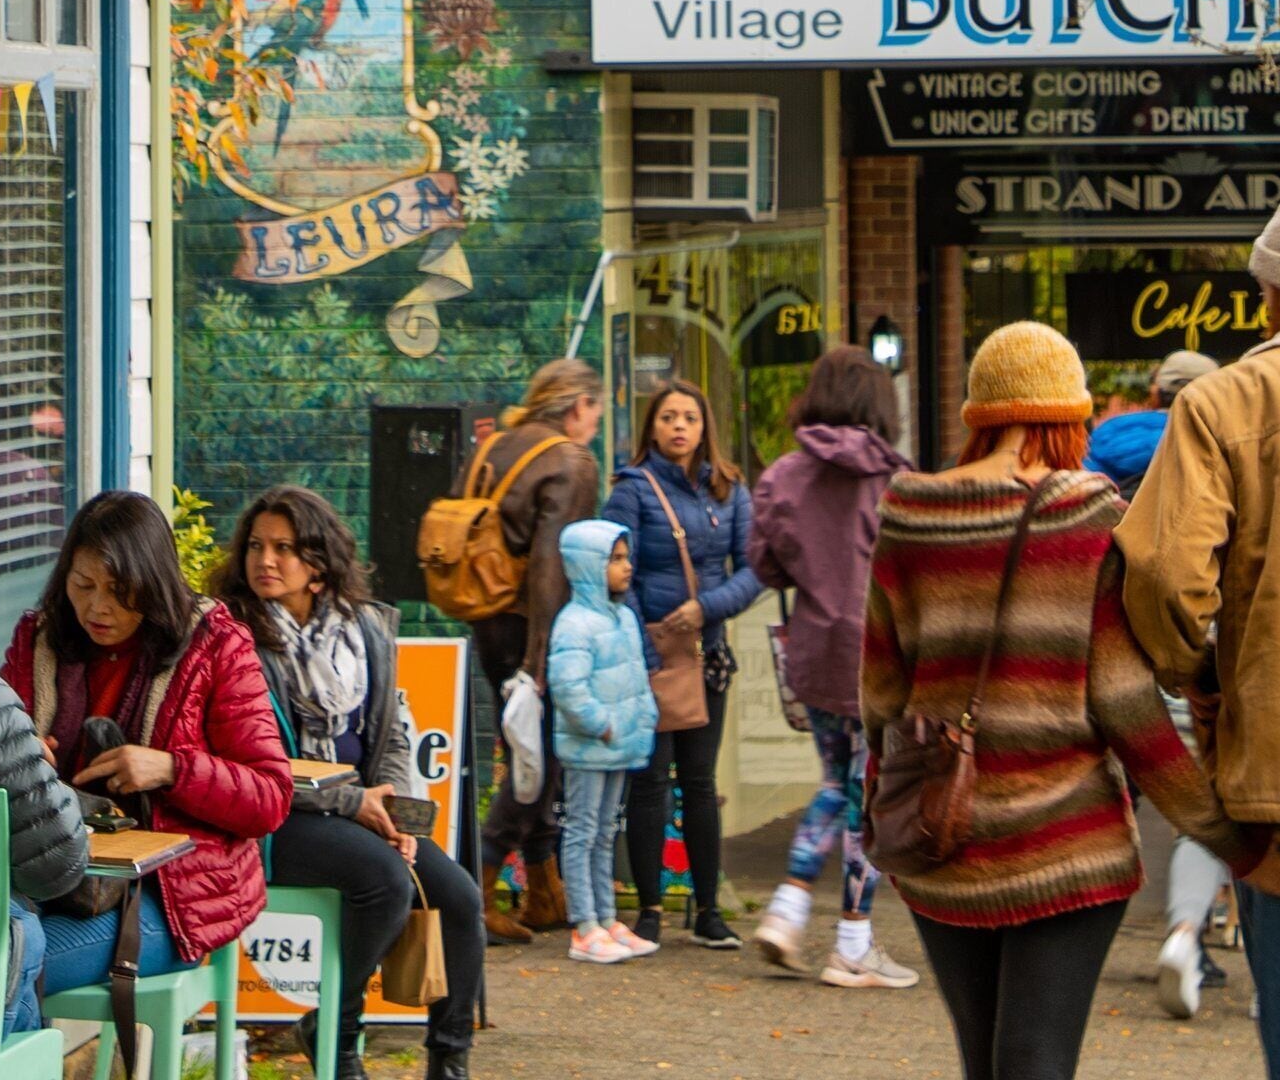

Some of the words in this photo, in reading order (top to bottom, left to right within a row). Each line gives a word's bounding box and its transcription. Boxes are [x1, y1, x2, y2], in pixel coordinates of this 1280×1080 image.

[653, 0, 843, 49] Village
[919, 73, 1023, 98] VINTAGE
[1033, 70, 1162, 96] CLOTHING
[931, 109, 1018, 135] UNIQUE
[1025, 108, 1097, 134] GIFTS
[1151, 106, 1249, 132] DENTIST
[955, 174, 1182, 215] STRAND
[250, 177, 460, 278] LEURA
[1132, 280, 1231, 352] Cafe
[245, 937, 311, 963] 4784
